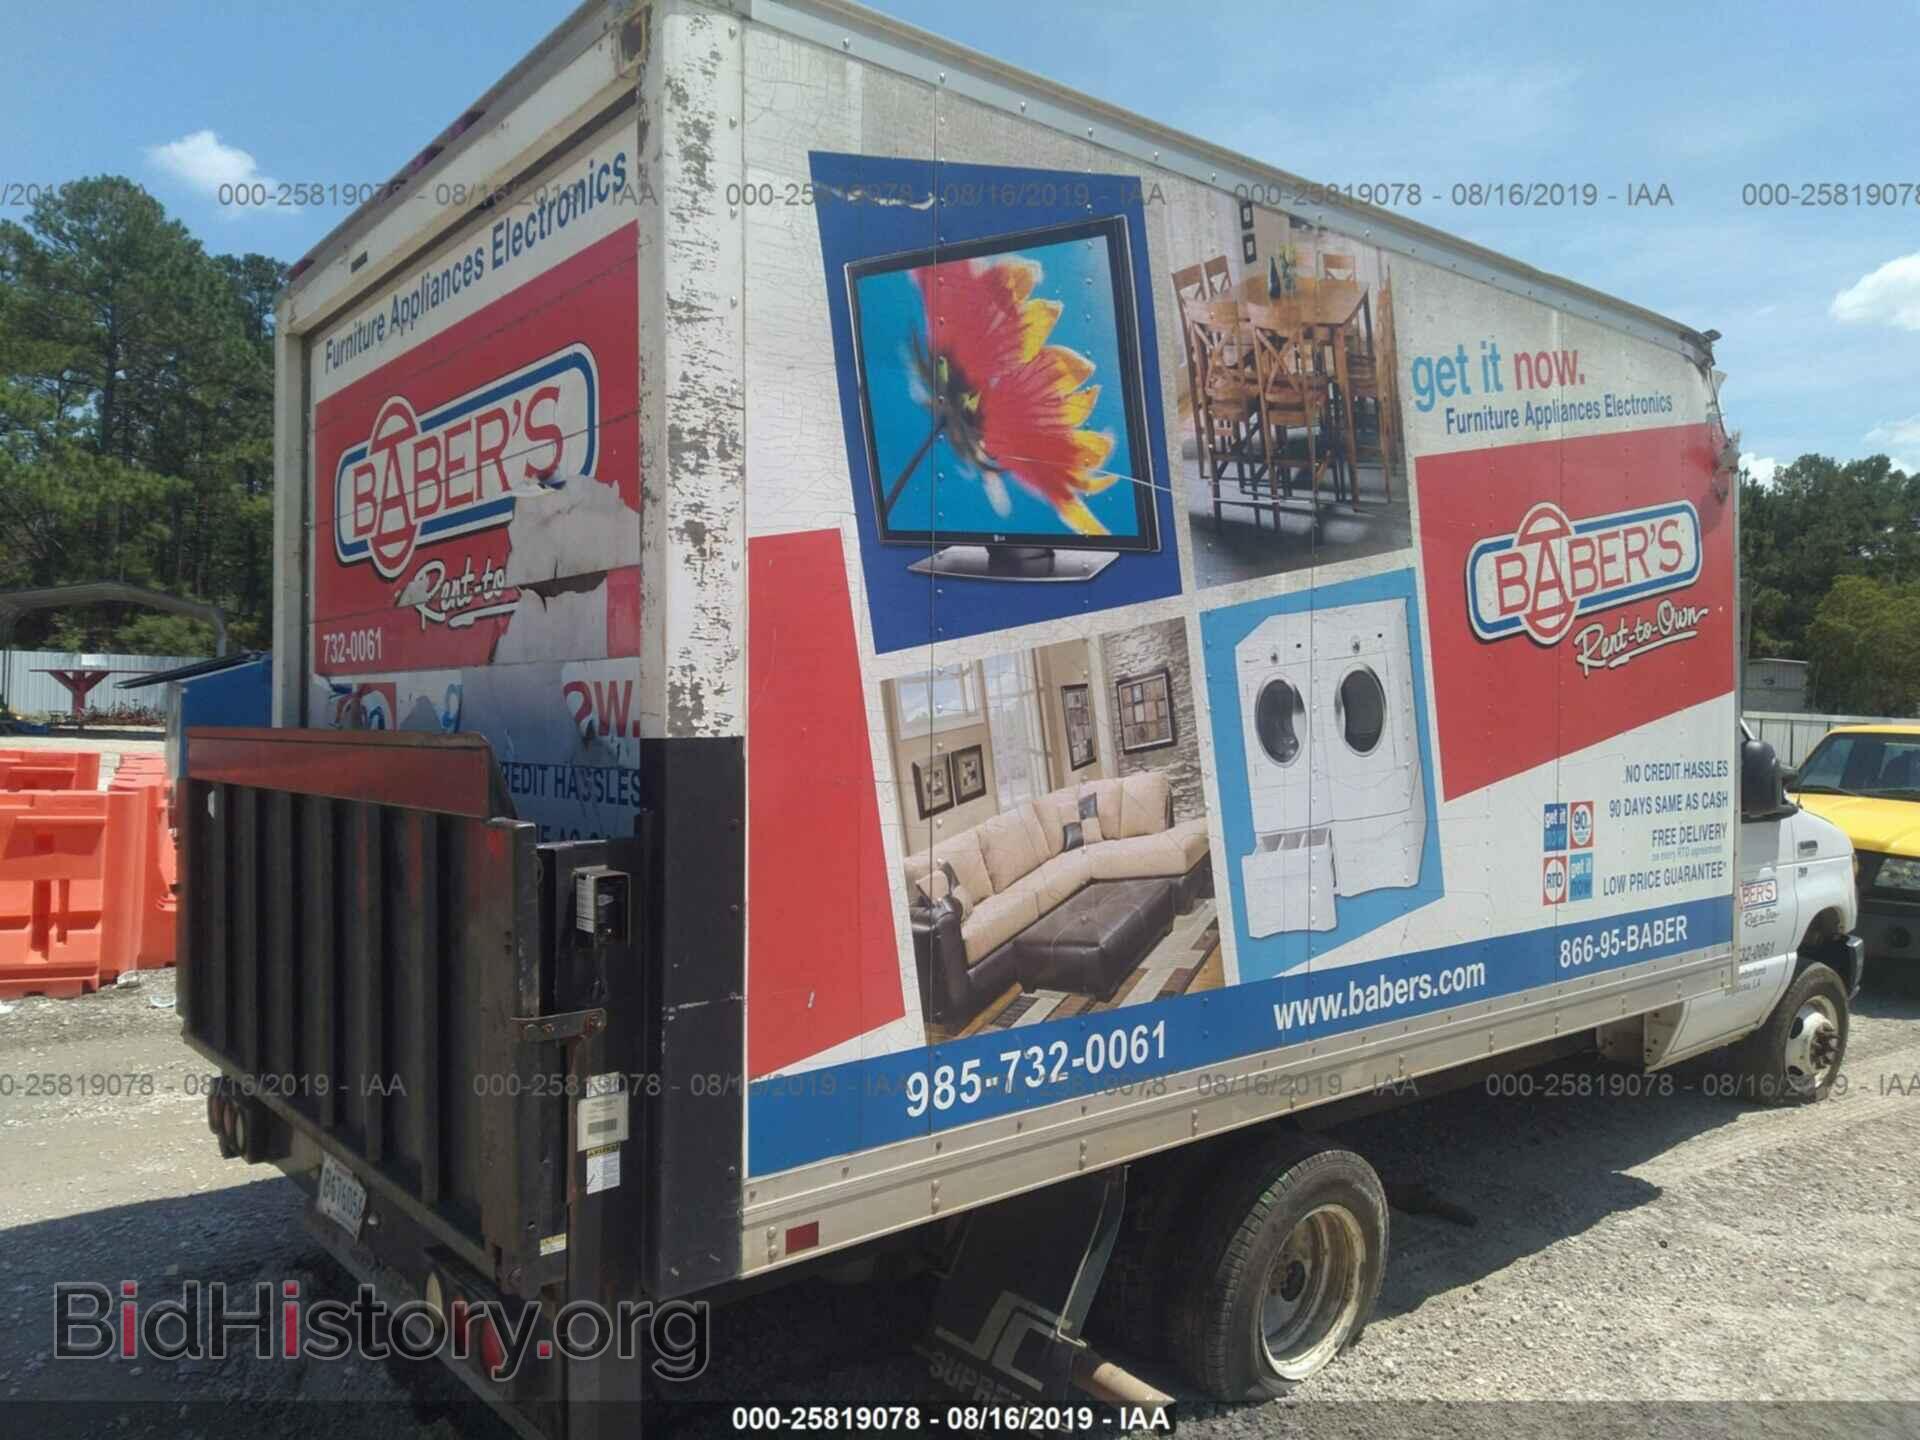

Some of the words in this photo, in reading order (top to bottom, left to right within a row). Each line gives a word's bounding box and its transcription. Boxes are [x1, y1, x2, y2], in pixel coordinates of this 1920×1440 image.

[324, 311, 386, 374] Furniture
[389, 246, 485, 336] Appliances
[491, 151, 627, 271] Electronics
[1411, 343, 1471, 413] get
[1480, 340, 1504, 394] it
[1513, 350, 1586, 391] now.
[1446, 404, 1520, 435] Furniture
[1525, 398, 1601, 431] Appliances
[1605, 390, 1673, 418] Electronics
[353, 386, 564, 538] BABER'S
[1495, 518, 1683, 615] BABER'S
[323, 626, 383, 665] 732-0061
[1575, 600, 1708, 678] Rent-to-Own
[502, 762, 549, 797] REDIT
[1625, 764, 1641, 783] NO
[1644, 762, 1681, 782] CREDIT
[1684, 760, 1729, 780] HASSLES
[1609, 799, 1621, 818] 90
[1624, 796, 1652, 817] DAYS
[1655, 794, 1683, 814] SAME
[1686, 792, 1699, 810] AS
[1702, 790, 1728, 809] CASH
[1652, 828, 1677, 848] FREE
[1680, 822, 1728, 846] DELIVERY
[1603, 874, 1627, 896] LOW
[1630, 870, 1662, 892] PRICE
[1560, 915, 1688, 969] 866-95-BABER
[1273, 962, 1486, 1031] www.babers.com
[906, 1020, 1166, 1118] 985-732-0061
